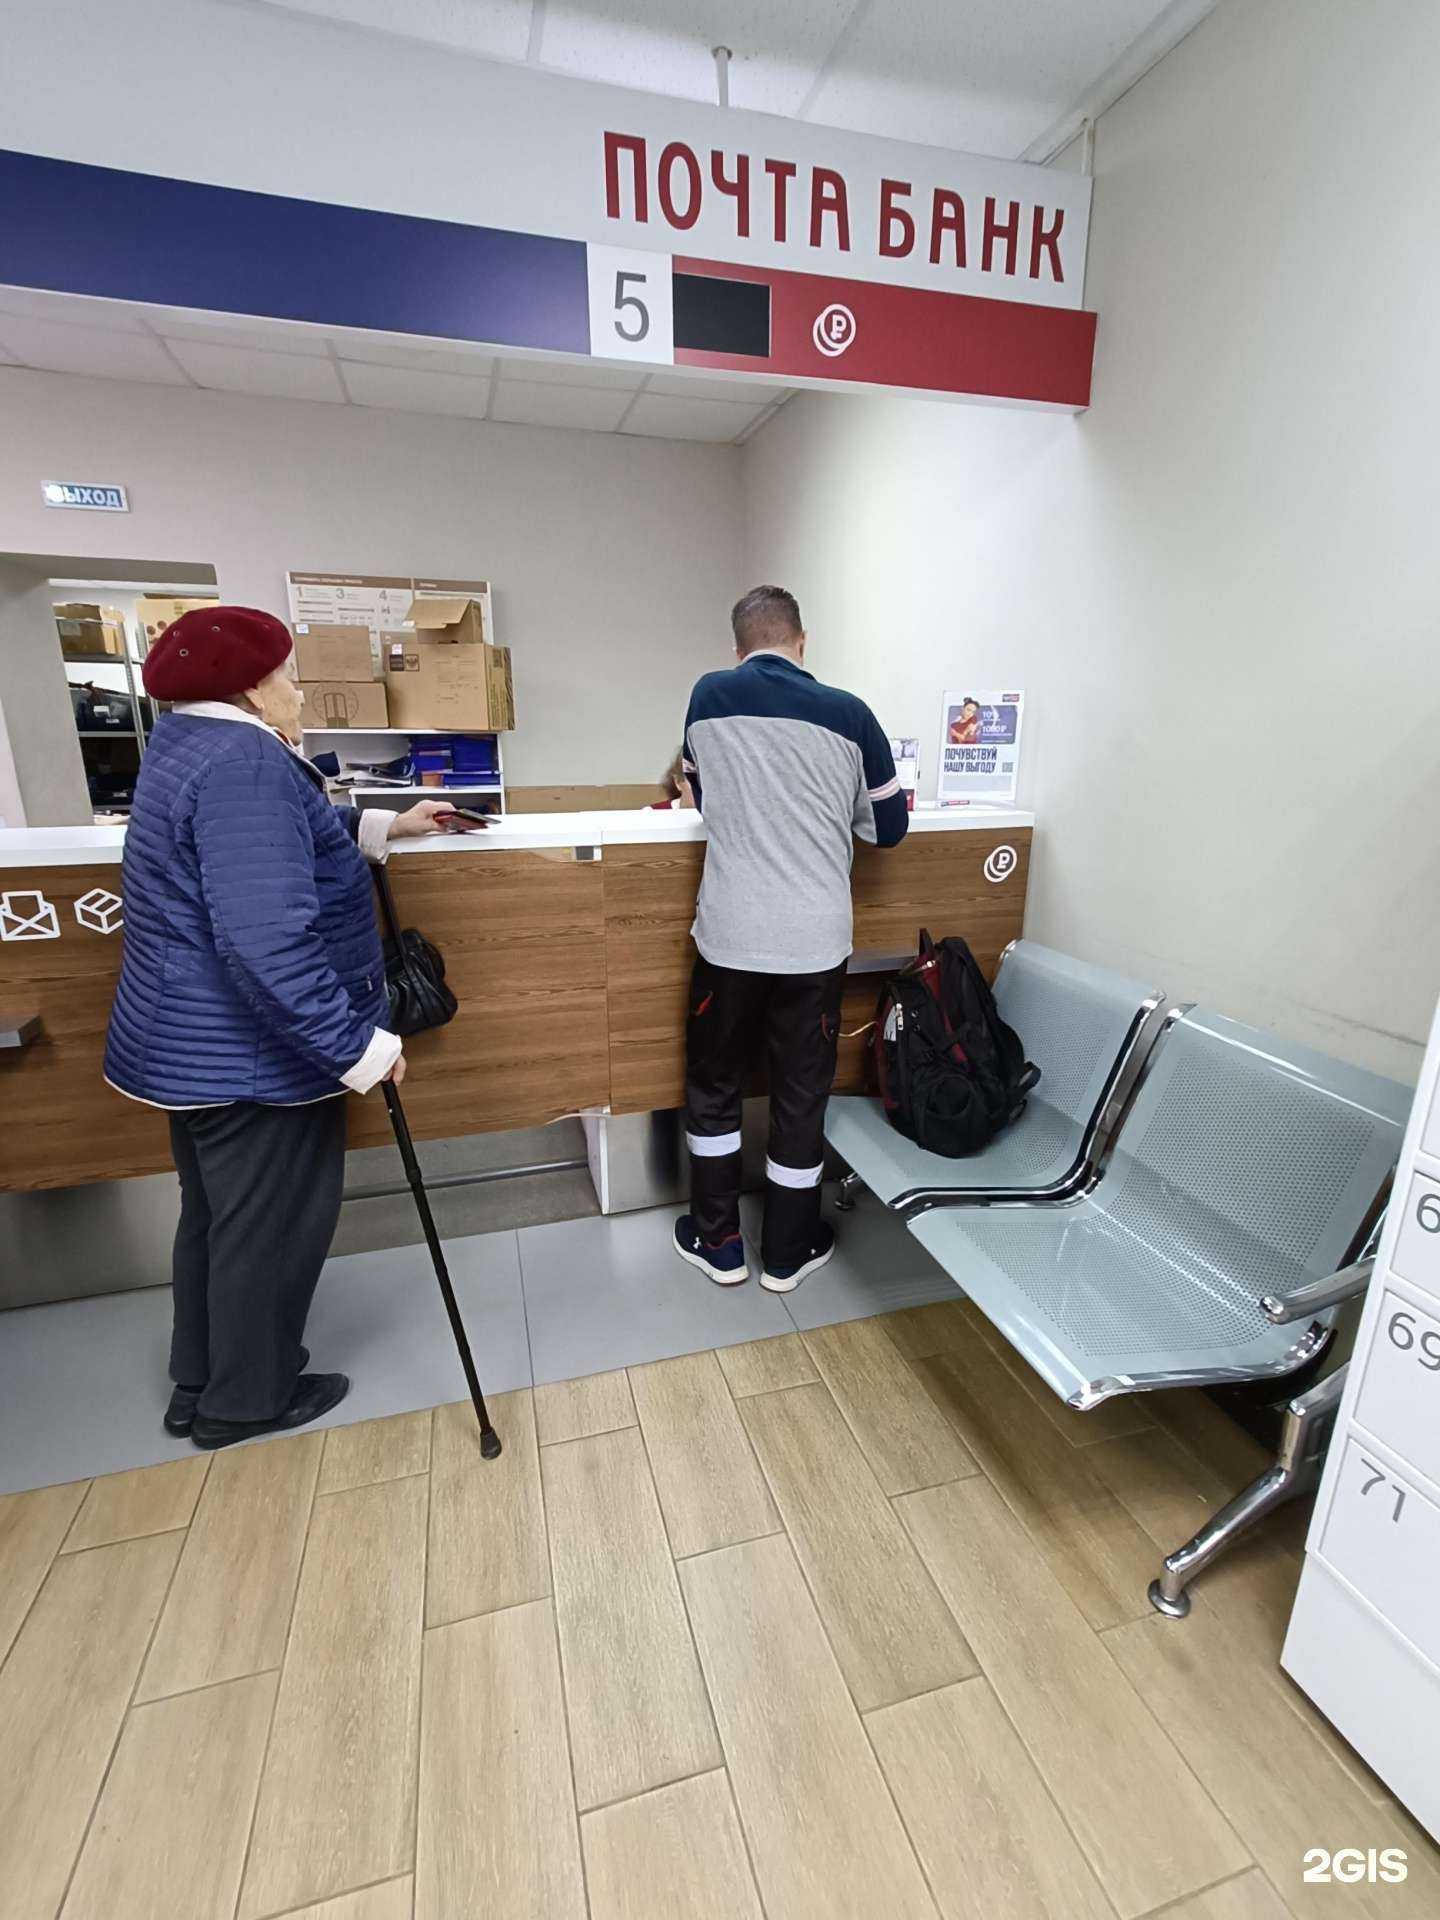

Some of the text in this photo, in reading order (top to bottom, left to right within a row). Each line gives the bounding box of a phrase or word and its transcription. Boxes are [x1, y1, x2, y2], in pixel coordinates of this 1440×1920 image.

[603, 131, 1065, 283] ПОЧТА БАНК
[613, 269, 651, 342] 5
[335, 587, 345, 600] 3
[379, 589, 388, 600] 4
[944, 762, 996, 773] НАШУ ВЫГОДУ
[945, 746, 998, 761] ПОЧУВСТВУЙ
[1388, 1312, 1440, 1371] 69
[1360, 1458, 1406, 1523] 71
